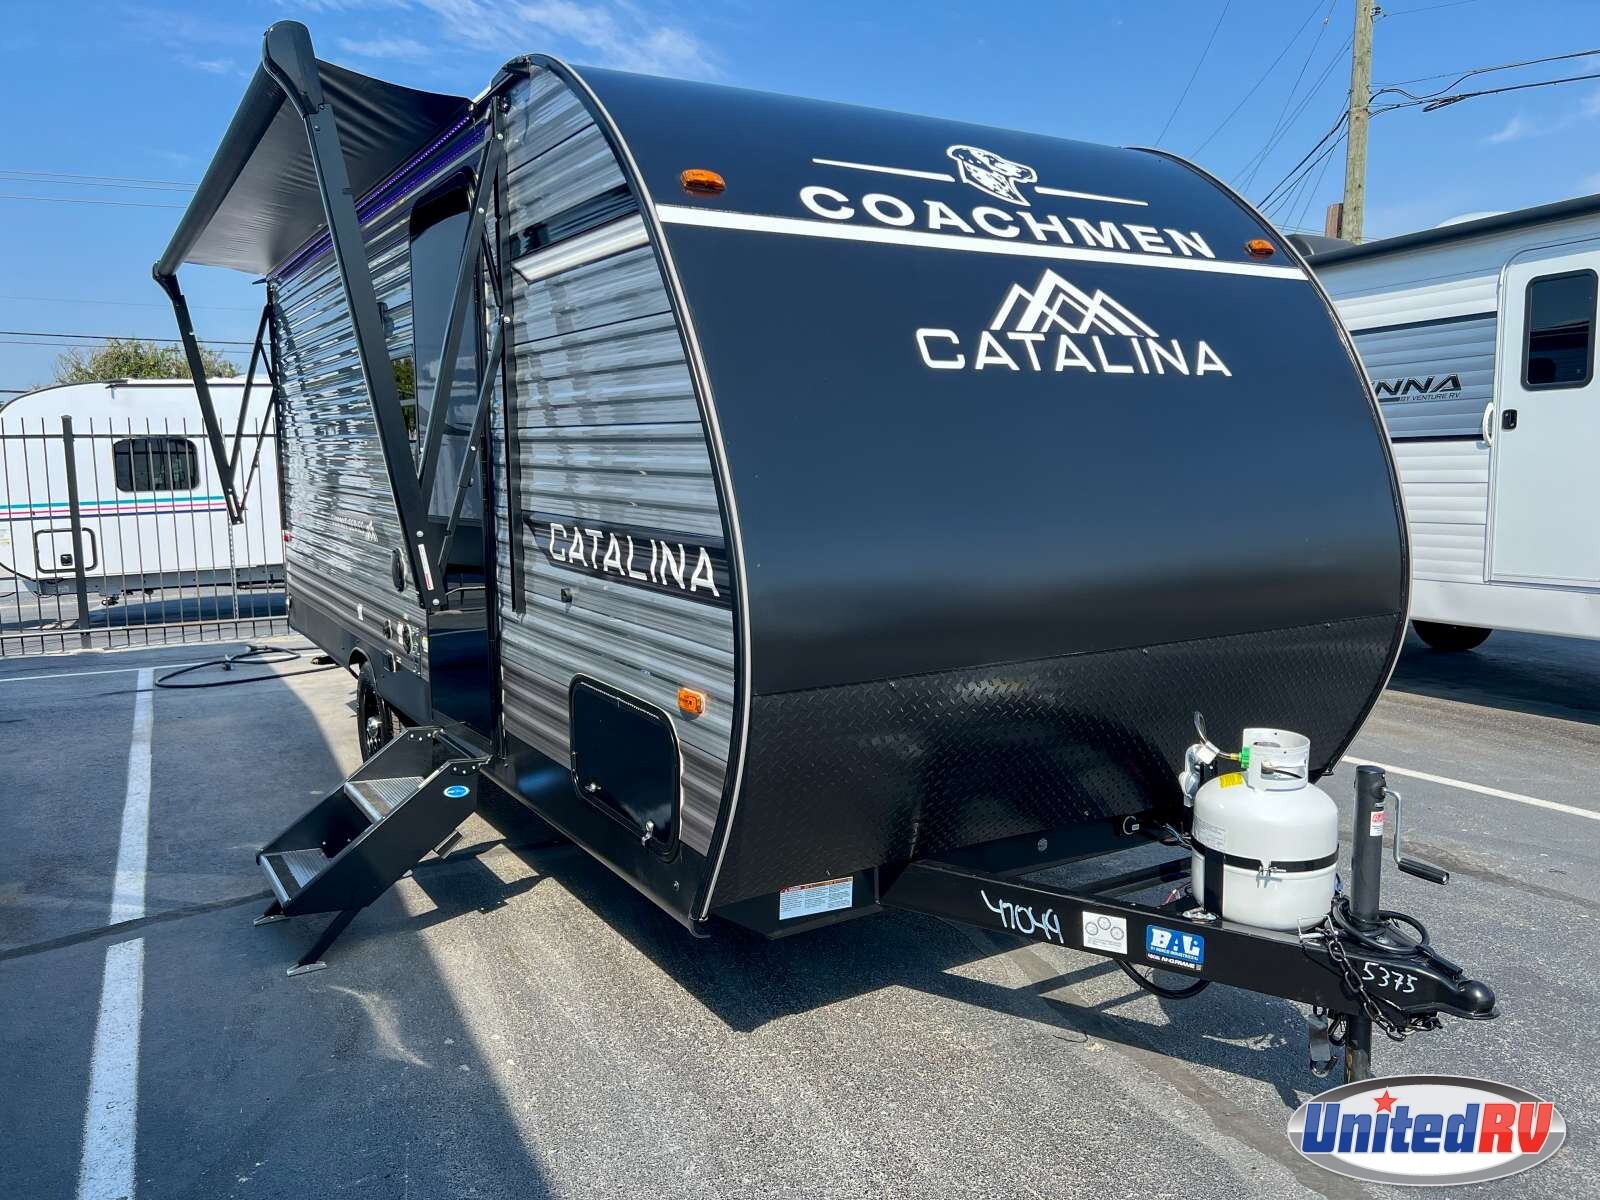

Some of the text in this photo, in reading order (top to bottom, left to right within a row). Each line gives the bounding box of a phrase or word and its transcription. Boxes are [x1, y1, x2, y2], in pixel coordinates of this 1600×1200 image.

[800, 185, 1215, 259] COACHMEN
[916, 327, 1233, 377] CATALINA
[1372, 373, 1461, 395] NNA
[1412, 392, 1447, 401] VENTURE
[1448, 391, 1461, 399] RV
[550, 522, 720, 598] CATALINA
[1150, 928, 1201, 957] BAL
[1362, 961, 1418, 993] 5375
